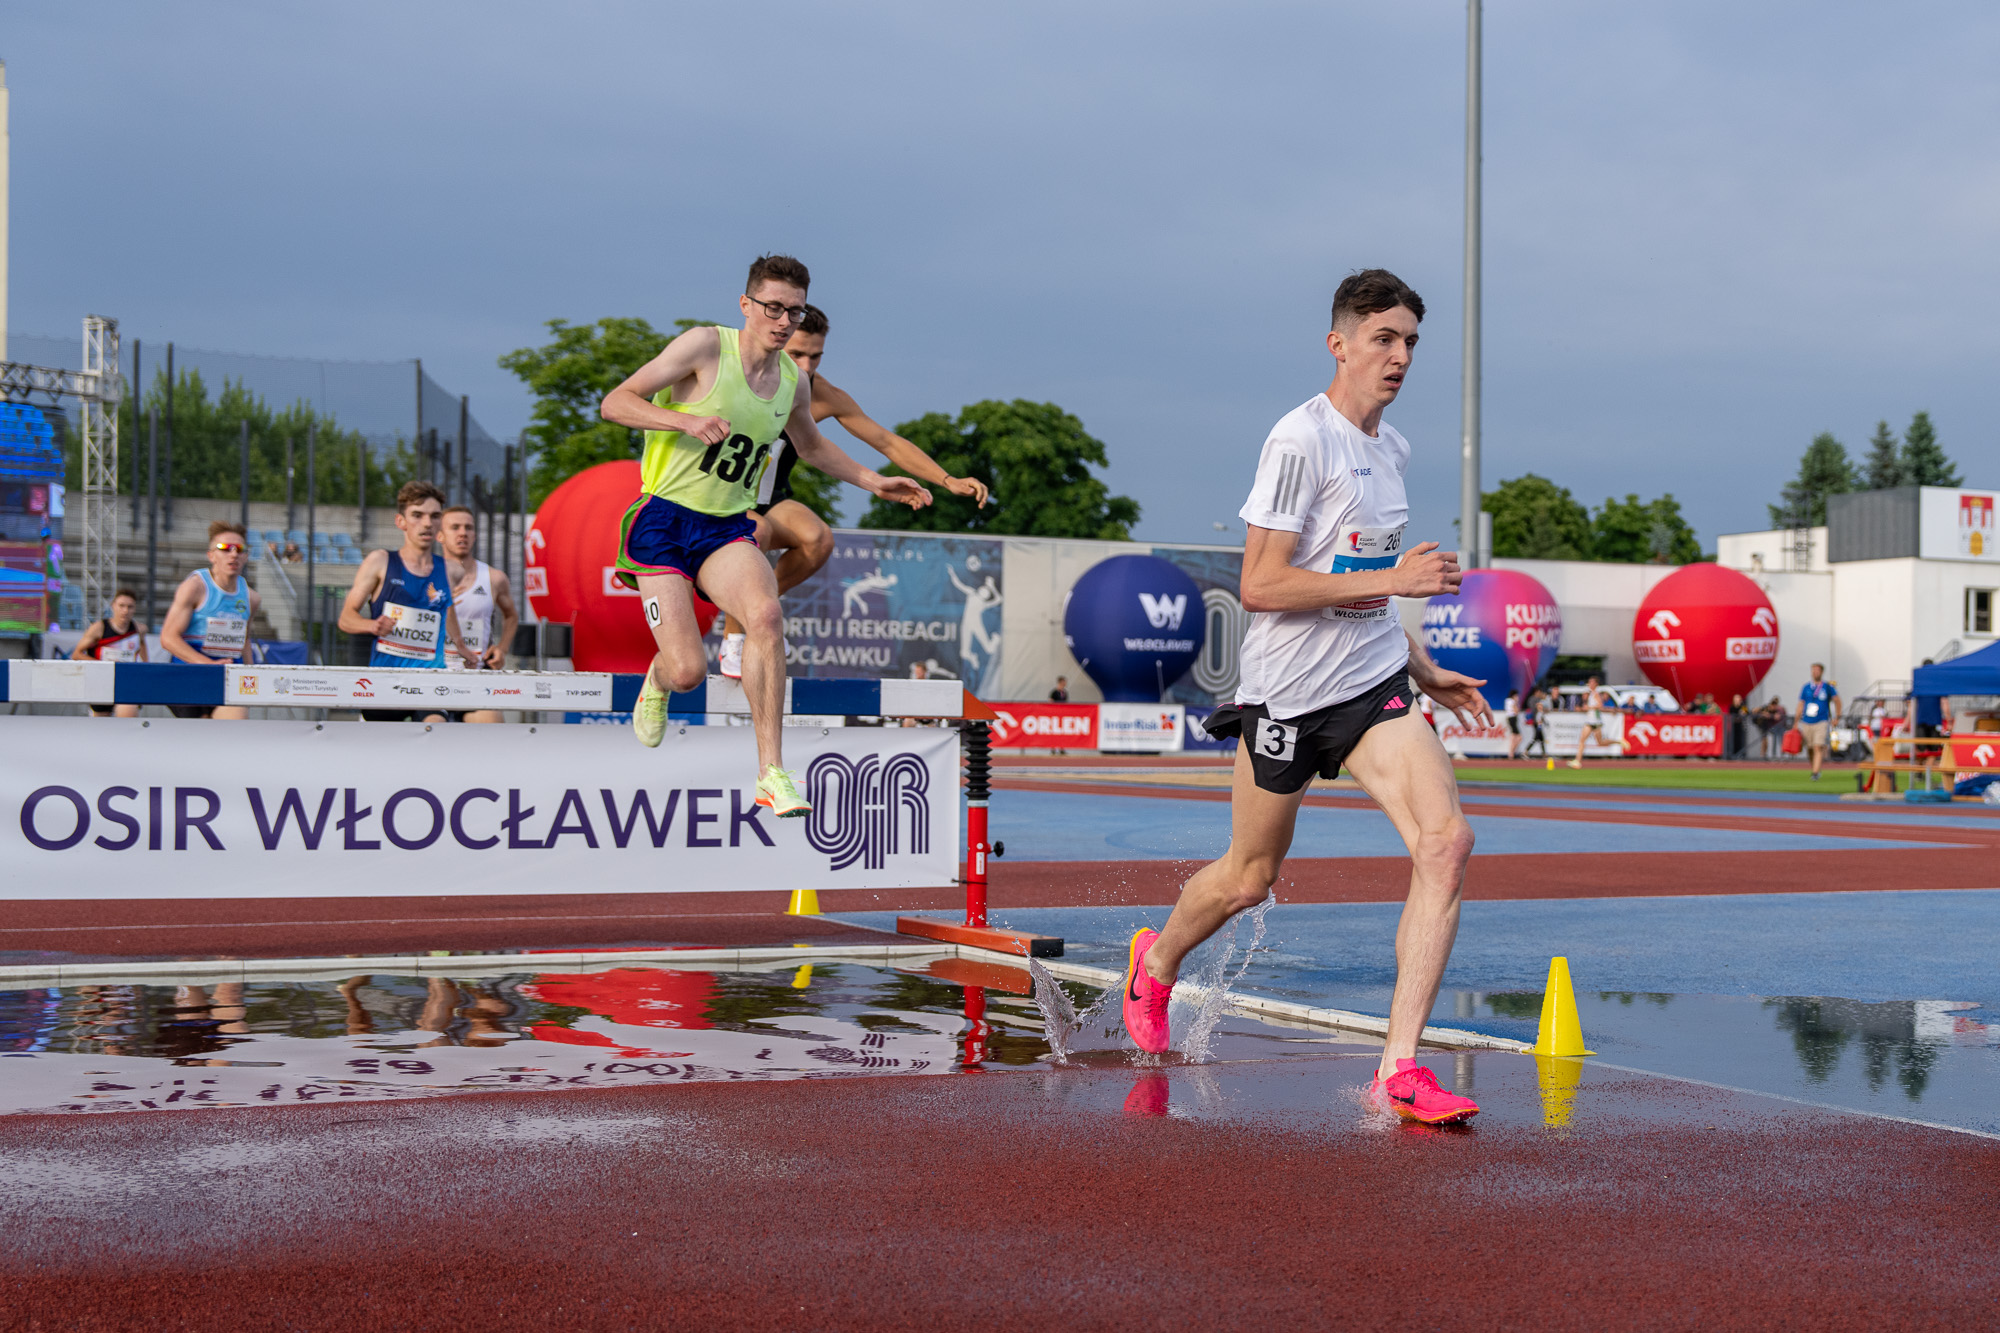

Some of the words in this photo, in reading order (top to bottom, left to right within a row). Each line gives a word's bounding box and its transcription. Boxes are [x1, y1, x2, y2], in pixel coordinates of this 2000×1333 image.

[417, 612, 436, 623] 194
[392, 627, 433, 642] NTOSZ
[783, 616, 831, 637] ORTU
[847, 619, 957, 642] REKREACJI
[1425, 627, 1481, 649] ORZE
[785, 644, 890, 668] OCŁAWKU
[492, 688, 522, 696] polanik
[1021, 715, 1091, 736] ORLEN
[1659, 724, 1715, 743] ORLEN
[1264, 724, 1286, 756] 3
[20, 785, 226, 851] OSIR
[246, 786, 776, 851] WŁOCŁAWEK
